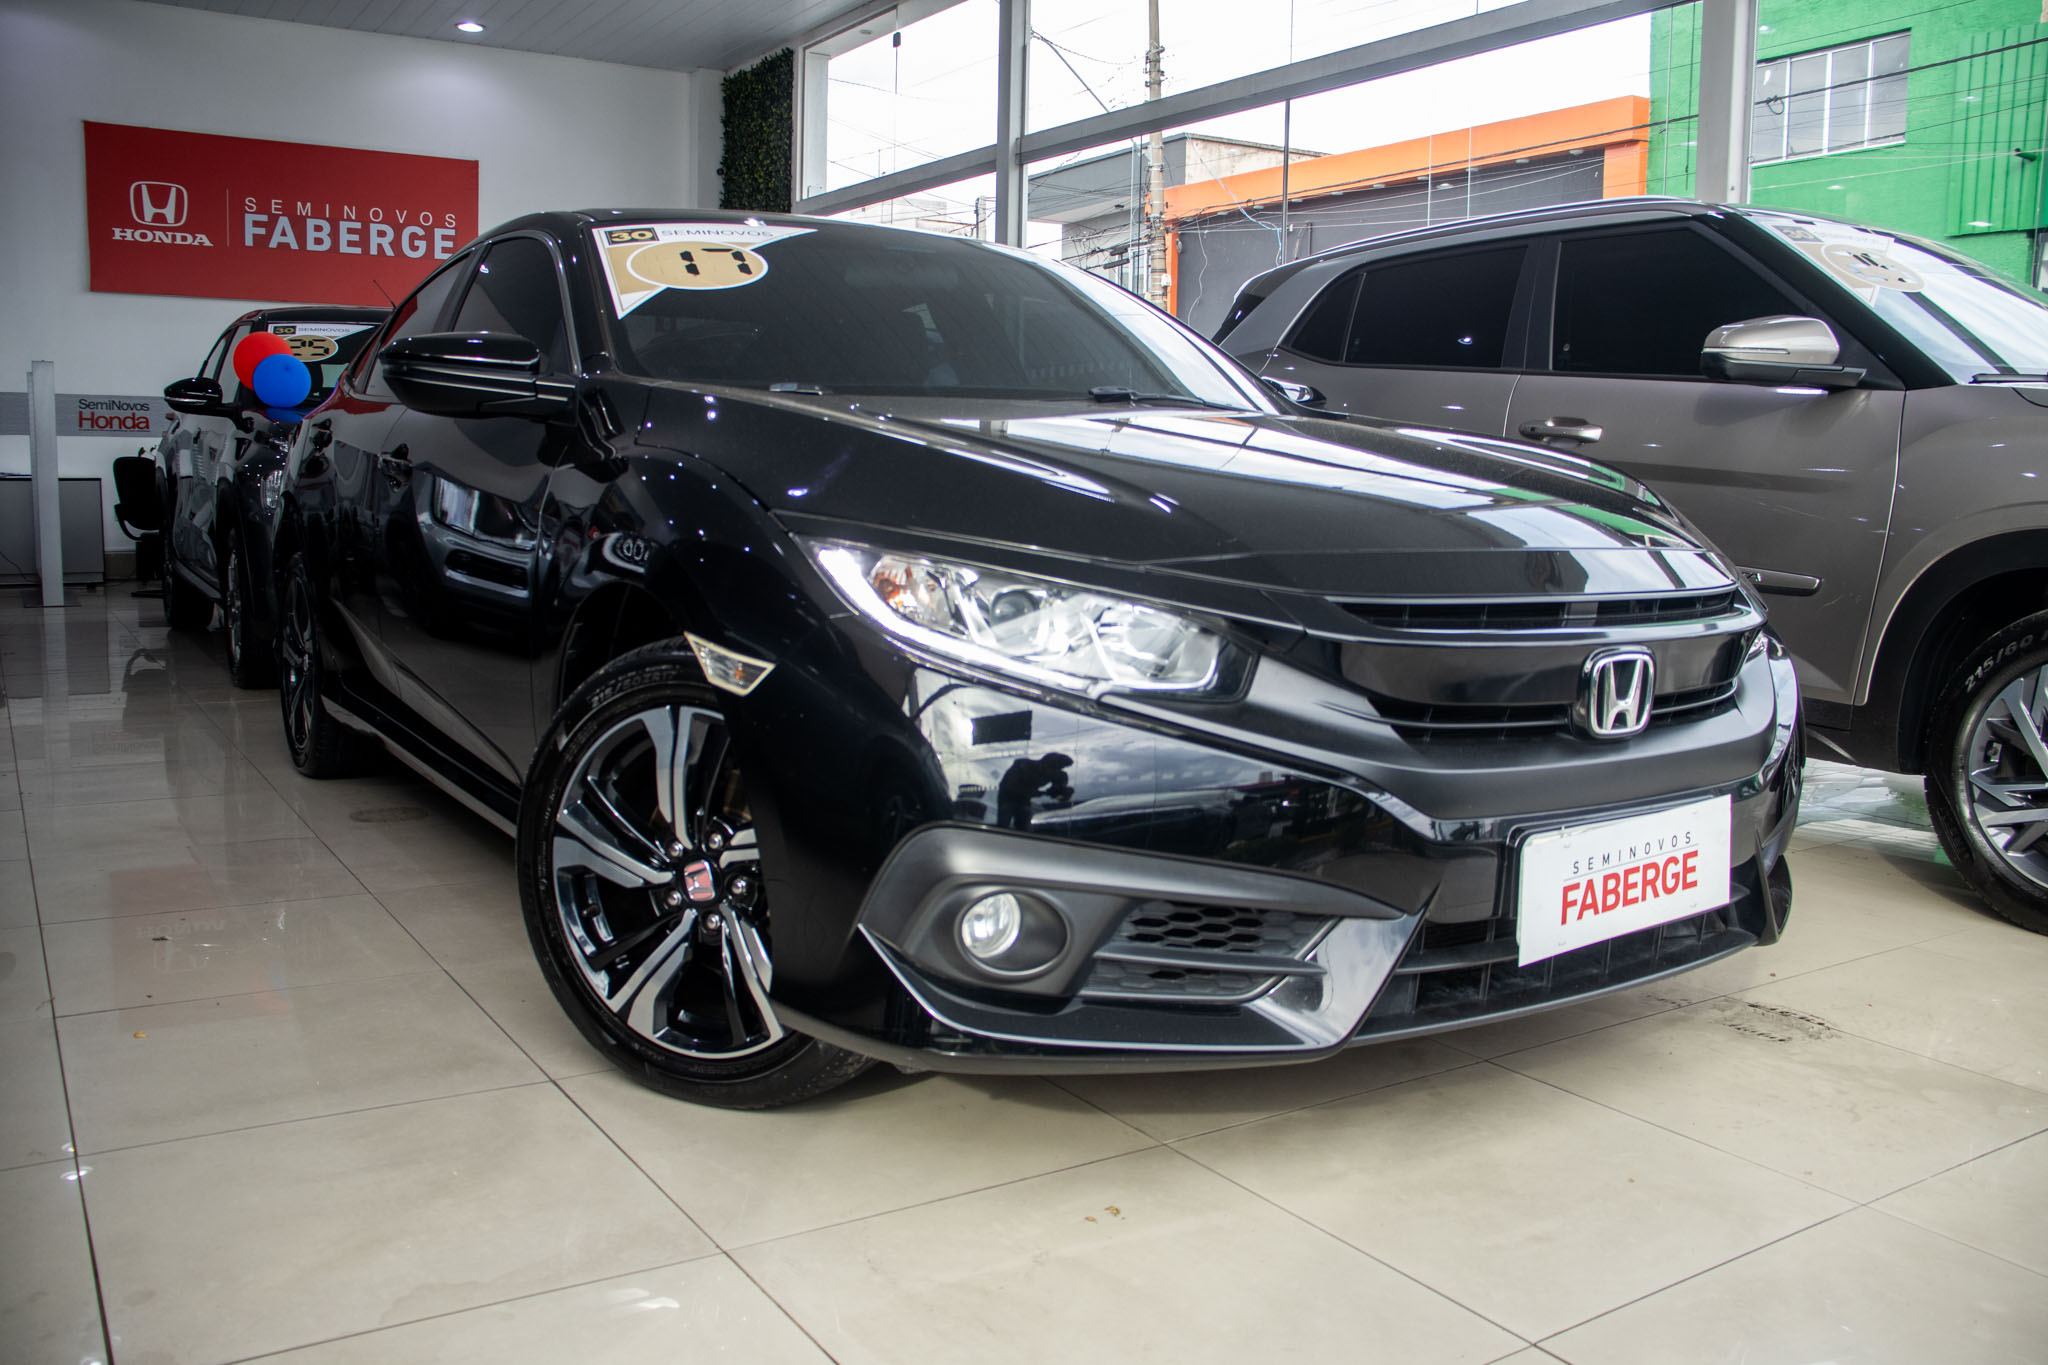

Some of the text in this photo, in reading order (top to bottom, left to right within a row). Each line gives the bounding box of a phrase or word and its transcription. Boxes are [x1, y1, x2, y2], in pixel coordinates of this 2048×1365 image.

[244, 196, 457, 229] SEMINOVOS
[111, 227, 214, 247] HONDA
[244, 213, 457, 261] FABERGE
[611, 229, 774, 242] 30 SEMINOVOS
[78, 398, 150, 412] SemiNovos
[78, 410, 150, 430] Honda
[1572, 831, 1693, 875] SEMINOVOS
[1560, 850, 1699, 926] FABERGE
